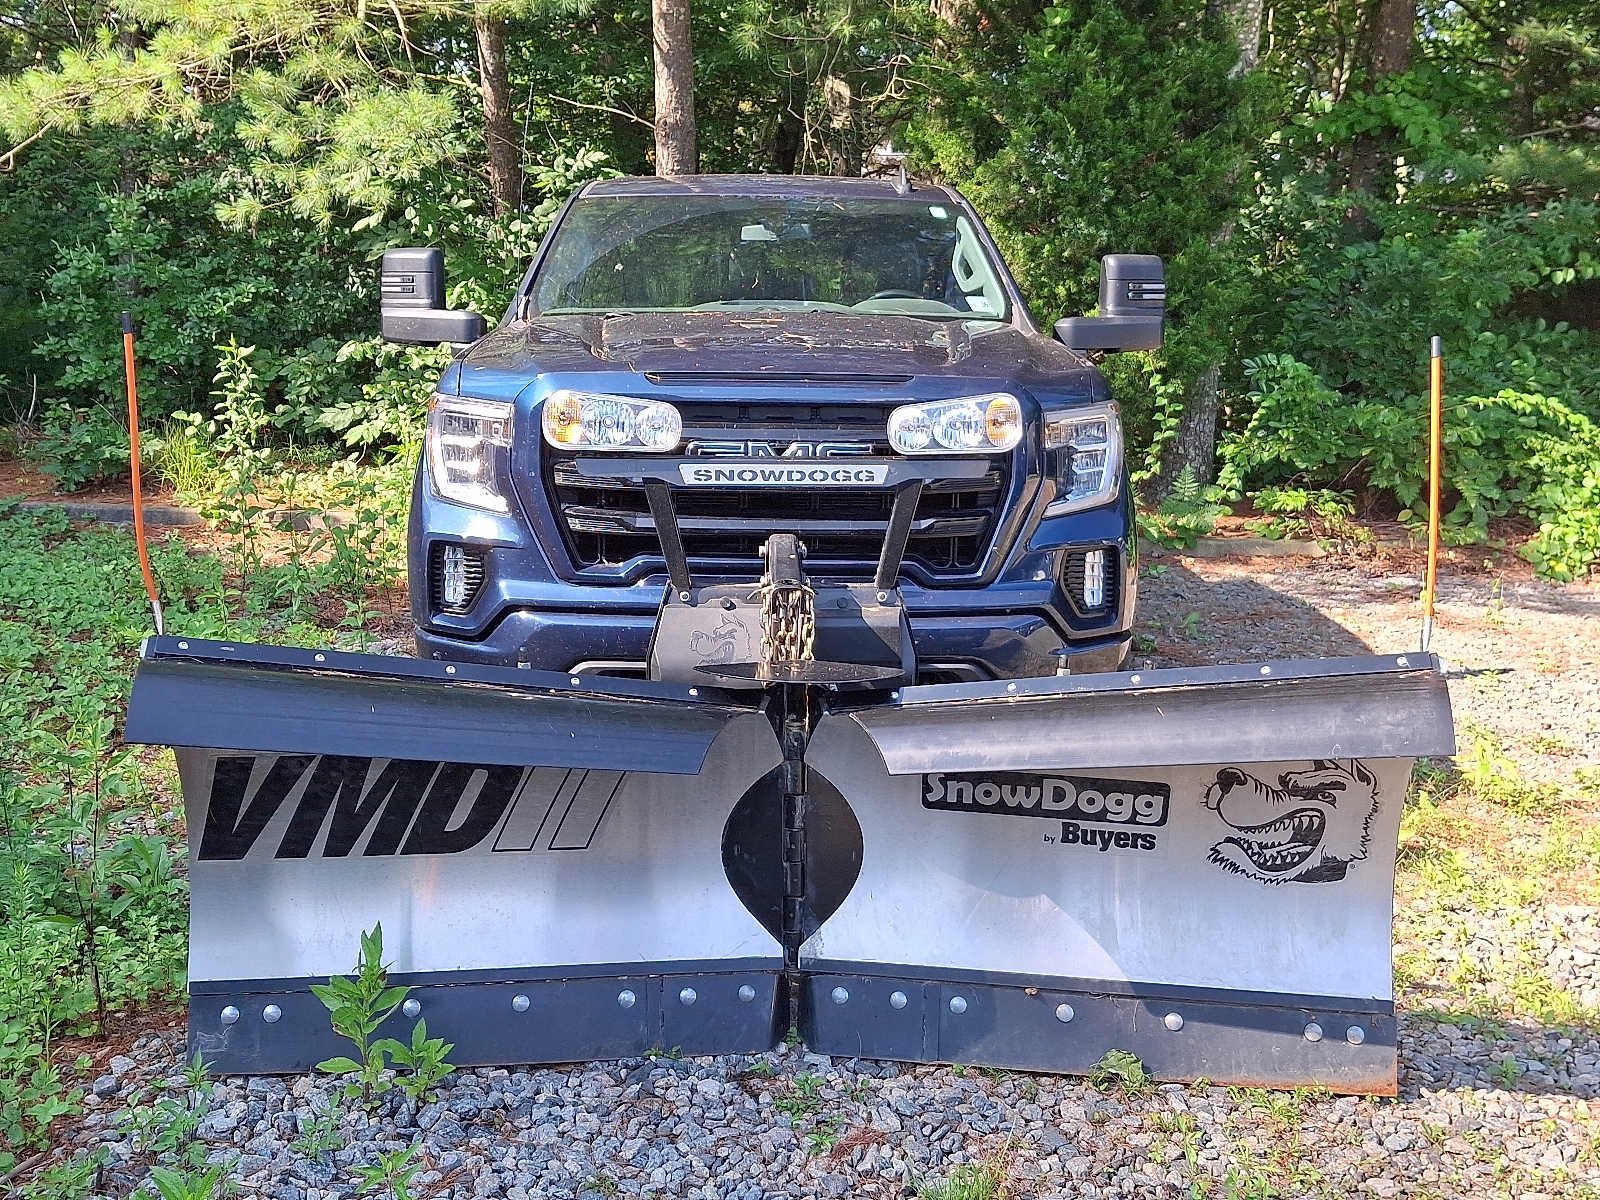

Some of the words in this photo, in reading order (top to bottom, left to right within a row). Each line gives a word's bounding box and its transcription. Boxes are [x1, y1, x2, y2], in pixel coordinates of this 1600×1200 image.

[693, 469, 875, 482] SNOWDOGG
[926, 773, 1164, 823] SnowDogg
[1043, 833, 1056, 845] by
[1061, 821, 1157, 852] Buyers
